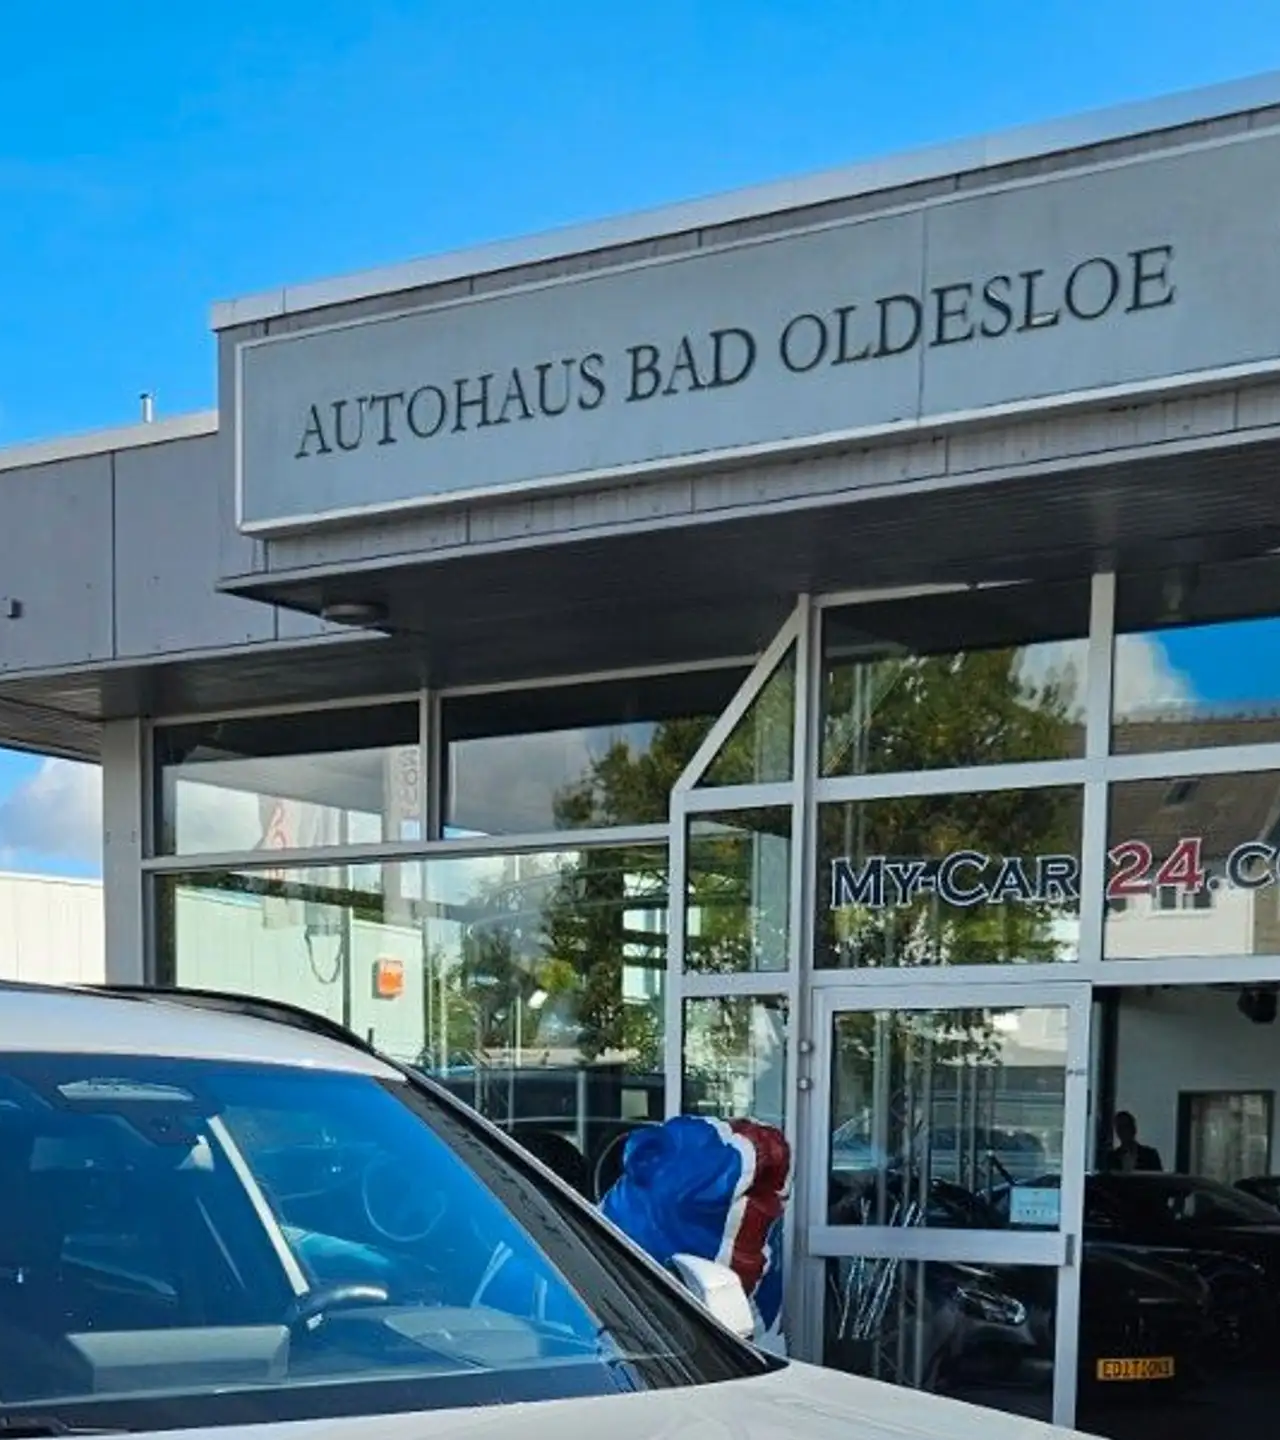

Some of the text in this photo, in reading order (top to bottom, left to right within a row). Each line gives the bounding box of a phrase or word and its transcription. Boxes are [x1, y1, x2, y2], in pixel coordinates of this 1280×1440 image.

[293, 243, 1177, 460] AUTOHAUS BAD OLDESLOE
